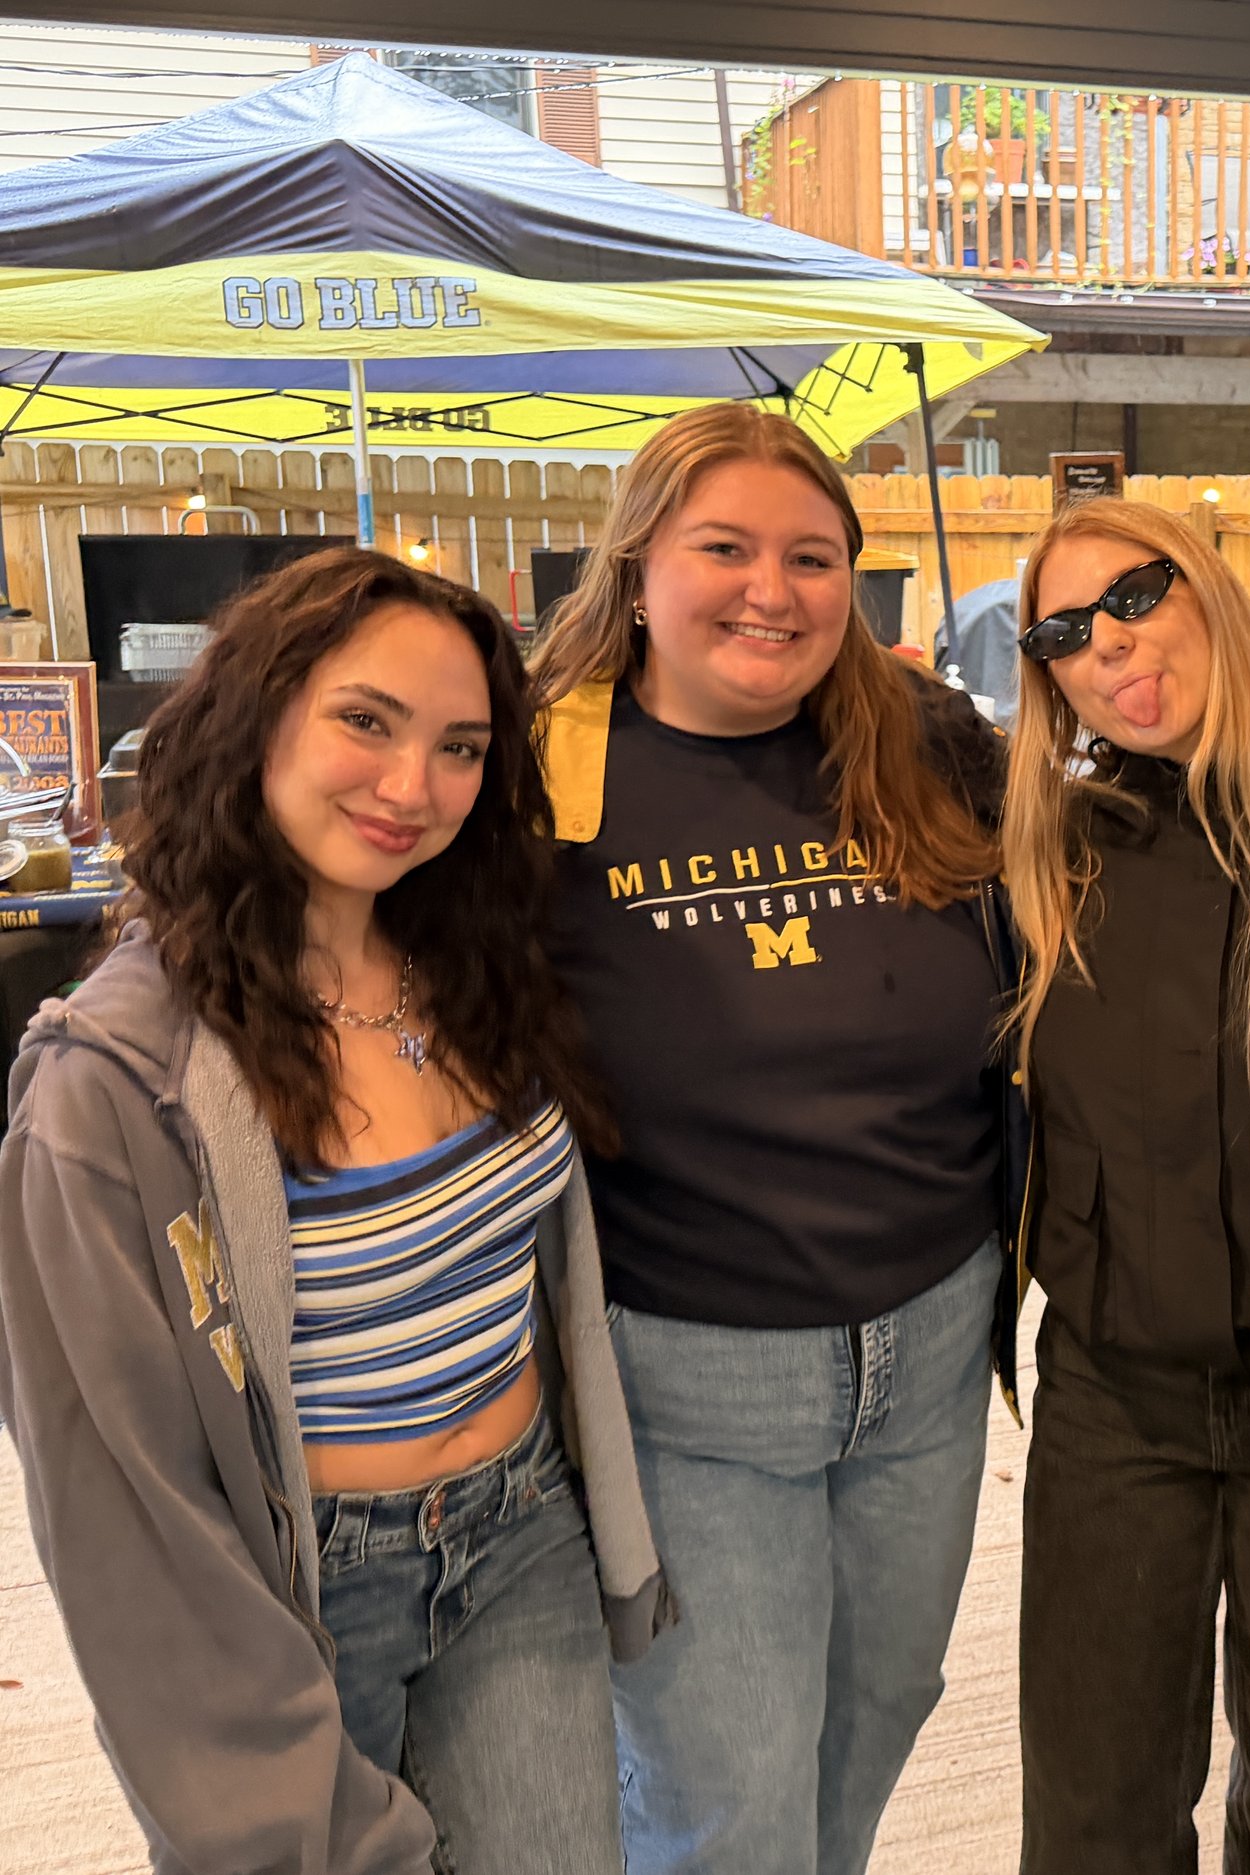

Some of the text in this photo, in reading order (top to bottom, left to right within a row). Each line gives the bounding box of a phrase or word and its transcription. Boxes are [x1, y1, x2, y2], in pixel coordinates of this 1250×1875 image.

[222, 276, 481, 330] GO BLUE
[606, 838, 868, 899] MICHIGA
[651, 885, 888, 930] WOLVERINES
[745, 915, 817, 969] M
